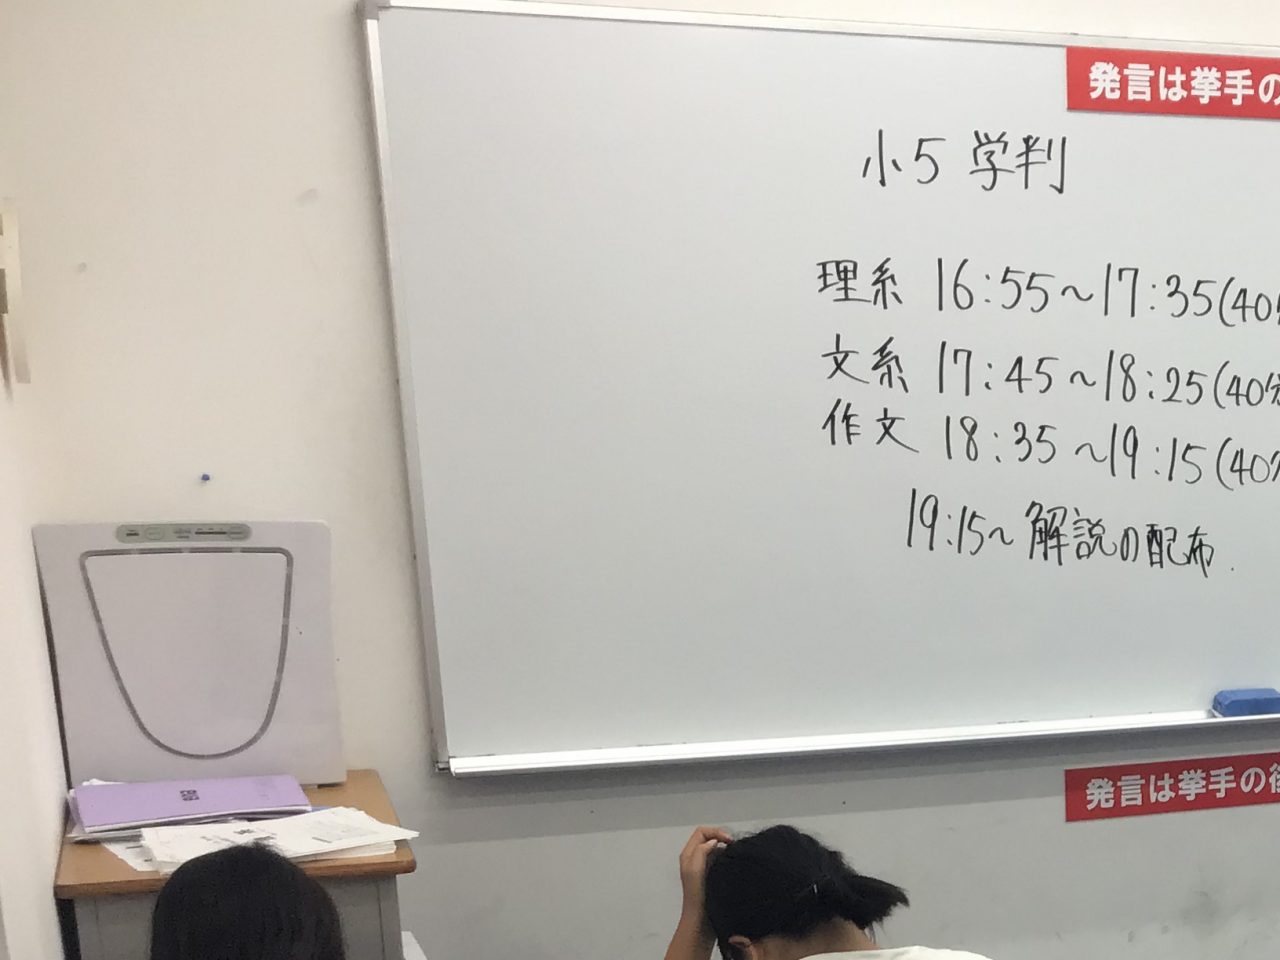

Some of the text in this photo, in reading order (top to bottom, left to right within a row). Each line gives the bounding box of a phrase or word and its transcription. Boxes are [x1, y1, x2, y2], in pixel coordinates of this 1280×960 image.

[862, 128, 946, 188] 小5
[815, 256, 904, 311] 理系
[820, 333, 910, 394] 文系
[821, 398, 920, 454] 作文
